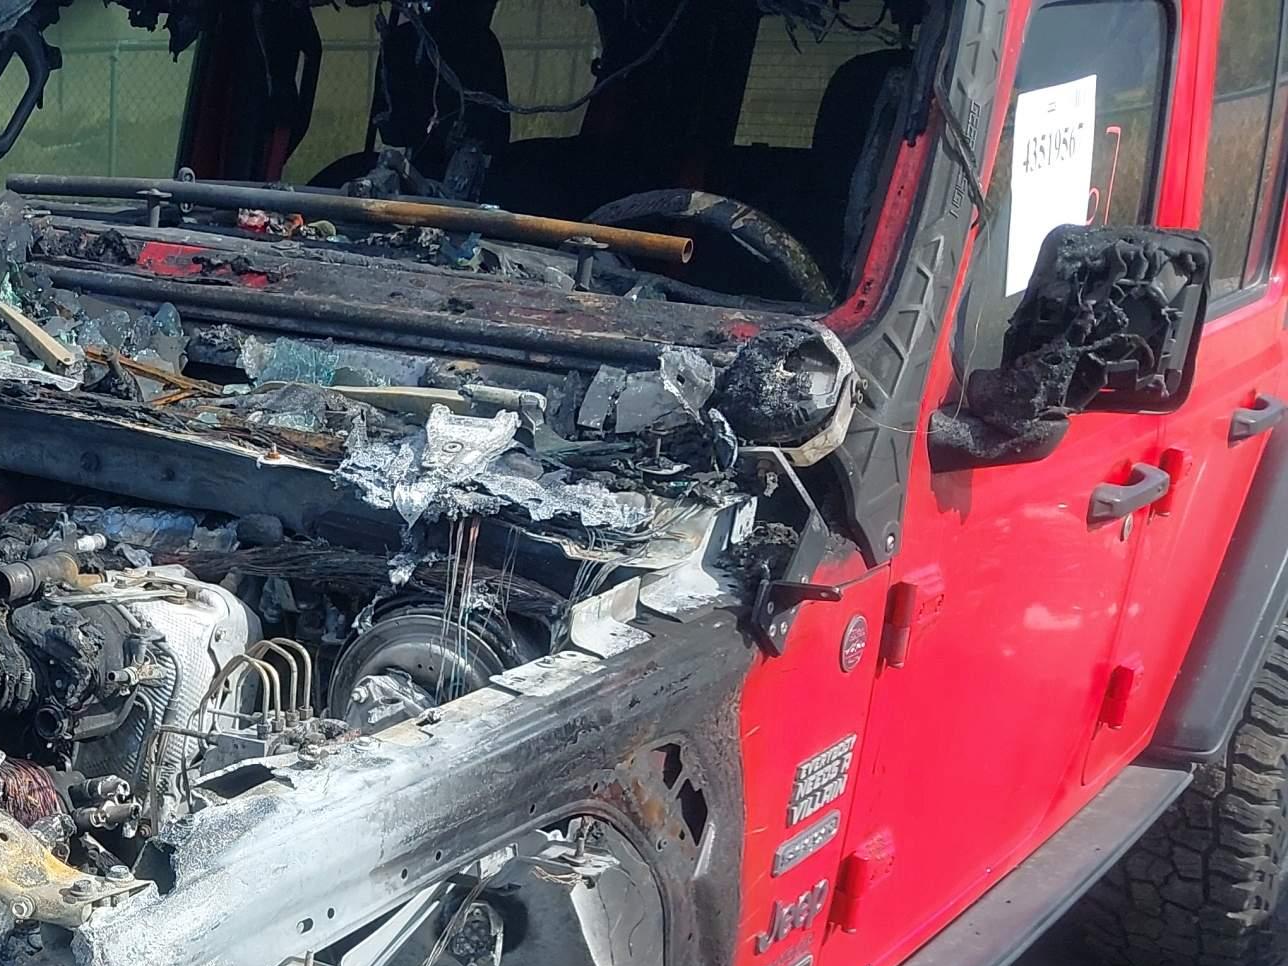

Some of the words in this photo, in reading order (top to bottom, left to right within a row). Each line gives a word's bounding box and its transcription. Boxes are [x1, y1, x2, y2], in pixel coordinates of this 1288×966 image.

[791, 772, 849, 826] VILLAIN
[795, 759, 840, 801] NEEDS
[756, 878, 829, 954] Jeep
